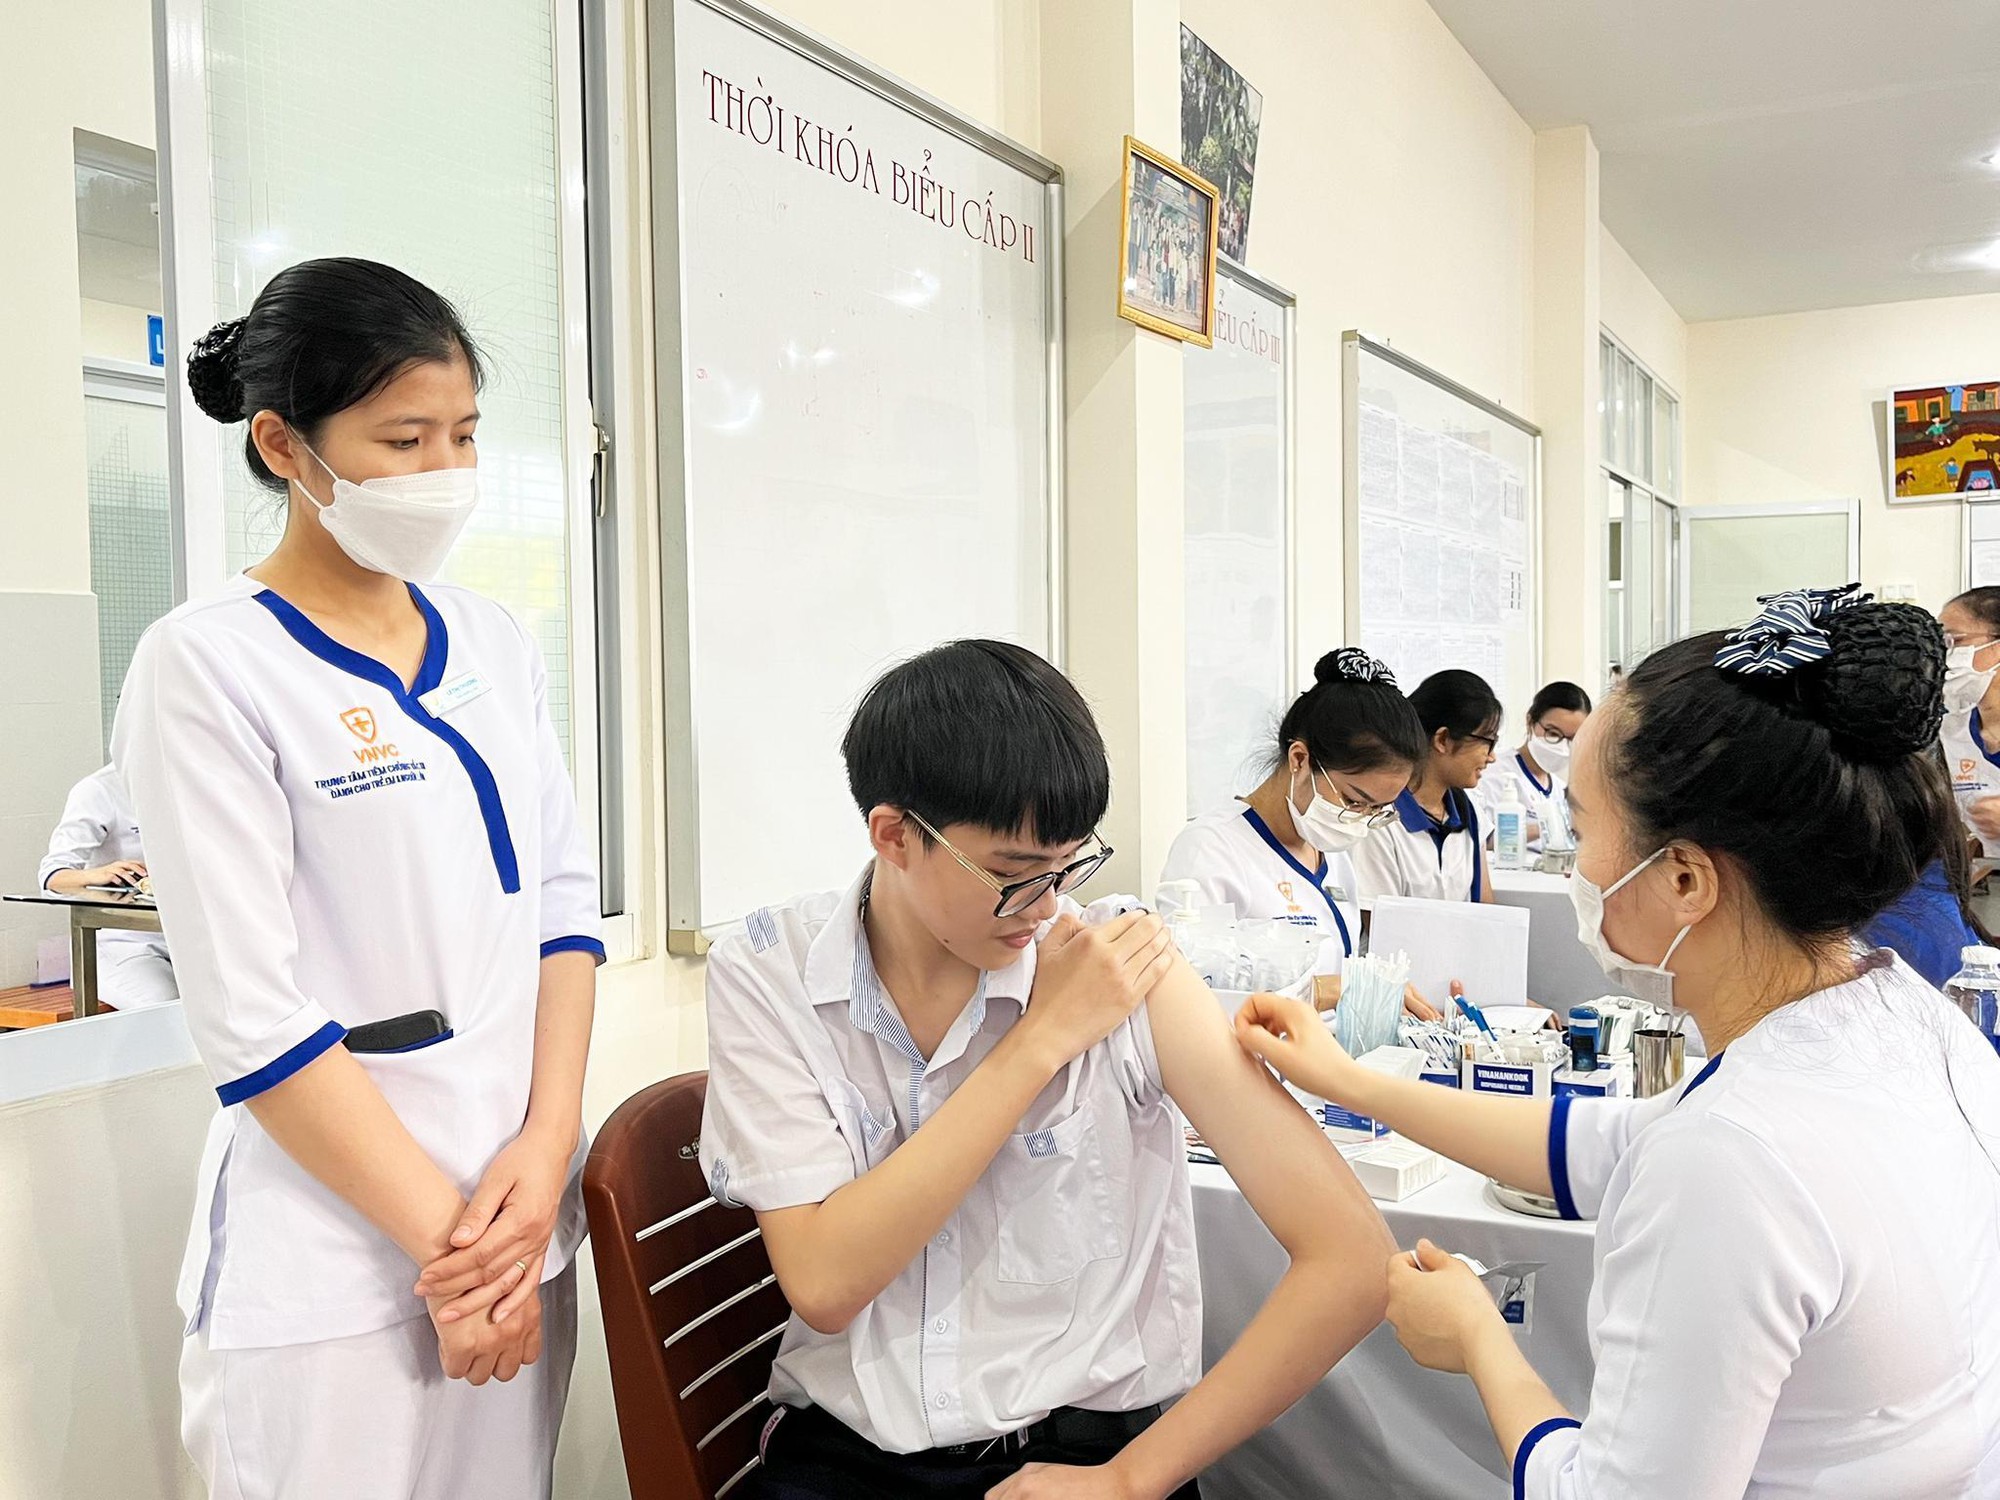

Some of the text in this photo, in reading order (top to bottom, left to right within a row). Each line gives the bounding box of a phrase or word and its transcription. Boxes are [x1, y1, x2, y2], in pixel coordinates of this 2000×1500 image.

[702, 69, 1035, 263] THỜI KHÓA BIỂU CẤP II
[1214, 289, 1280, 364] IỂU CẤP III
[353, 743, 399, 764] VNVC
[314, 776, 346, 789] TRUNG
[347, 771, 367, 782] TÂM
[331, 787, 353, 799] DÀNH
[354, 782, 371, 794] CHO
[1477, 1069, 1529, 1082] VINAHANKOOK
